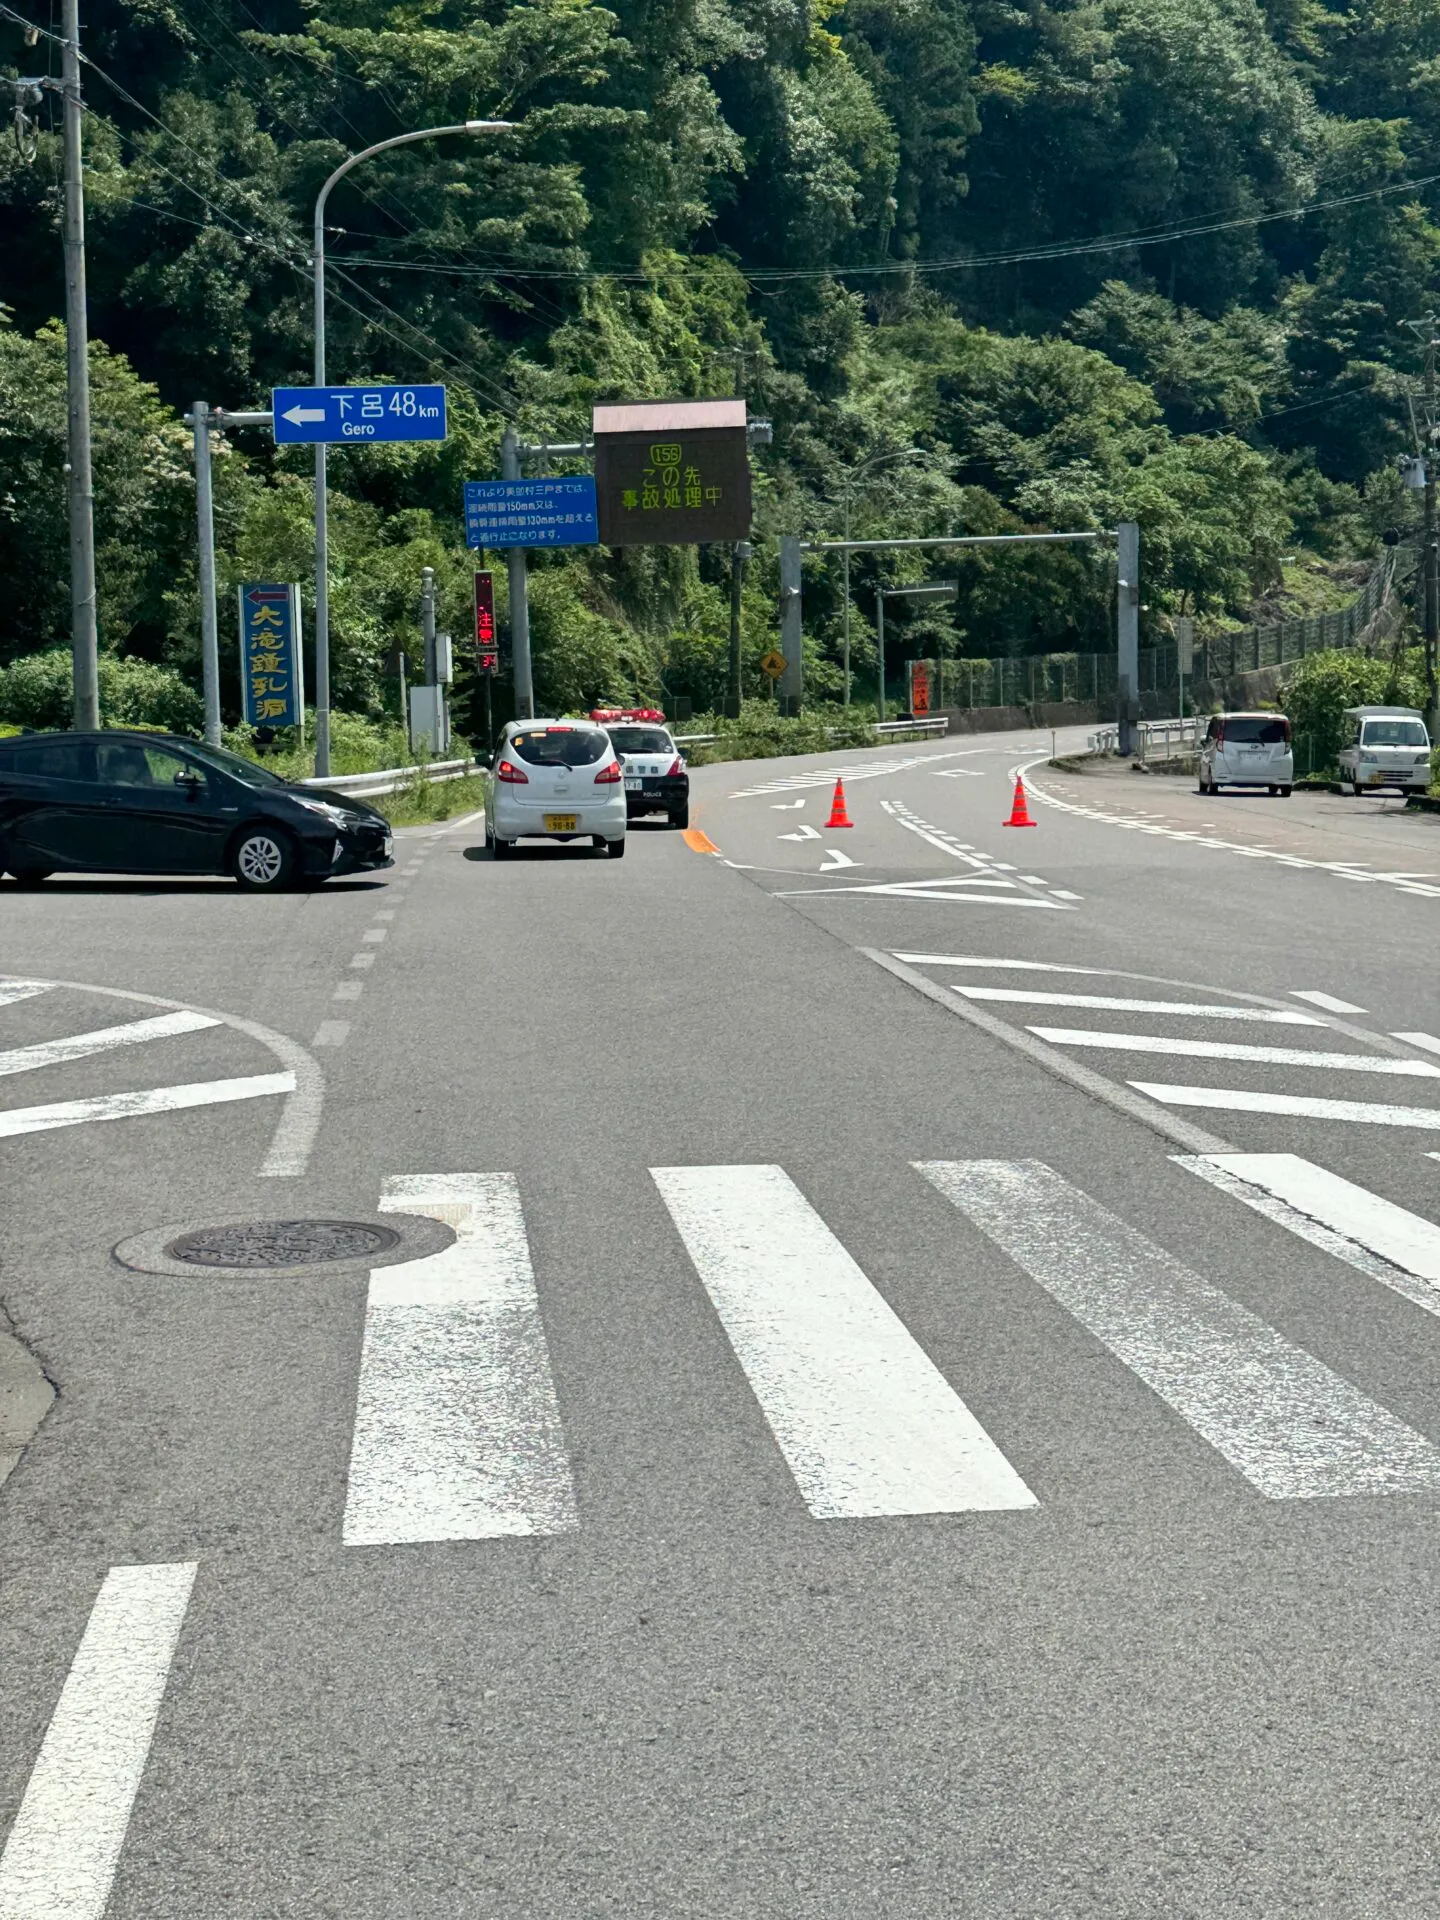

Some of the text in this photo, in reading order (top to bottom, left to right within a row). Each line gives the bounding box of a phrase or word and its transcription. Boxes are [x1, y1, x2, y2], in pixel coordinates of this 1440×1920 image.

[342, 422, 375, 436] Gero
[642, 466, 702, 489] この先
[622, 485, 722, 511] 事故処理中
